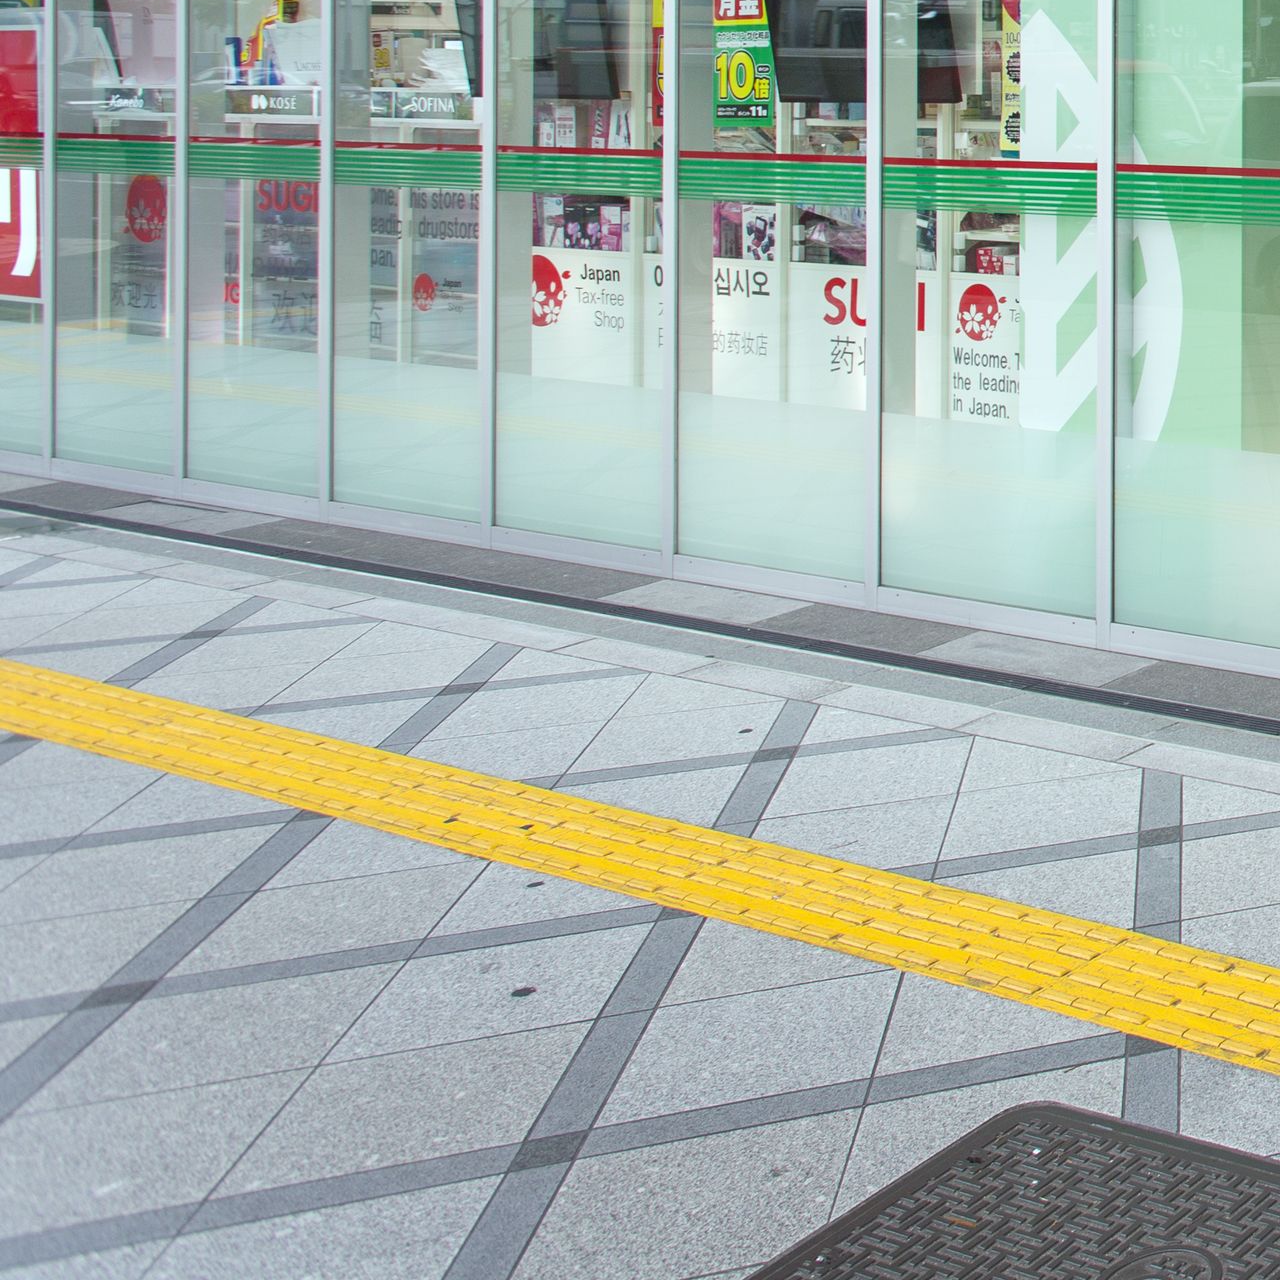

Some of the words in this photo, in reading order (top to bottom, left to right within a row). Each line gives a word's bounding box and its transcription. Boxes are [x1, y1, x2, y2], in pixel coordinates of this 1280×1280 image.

[269, 95, 297, 110] KOSÉ
[411, 97, 455, 113] SOFINA
[418, 216, 479, 241] drugstore
[580, 264, 620, 284] Japan
[576, 286, 624, 308] Tax-free
[594, 310, 624, 329] Shop
[954, 348, 1010, 370] Welcome.
[953, 374, 971, 391] the
[953, 398, 963, 413] in
[969, 398, 1009, 419] Japan.
